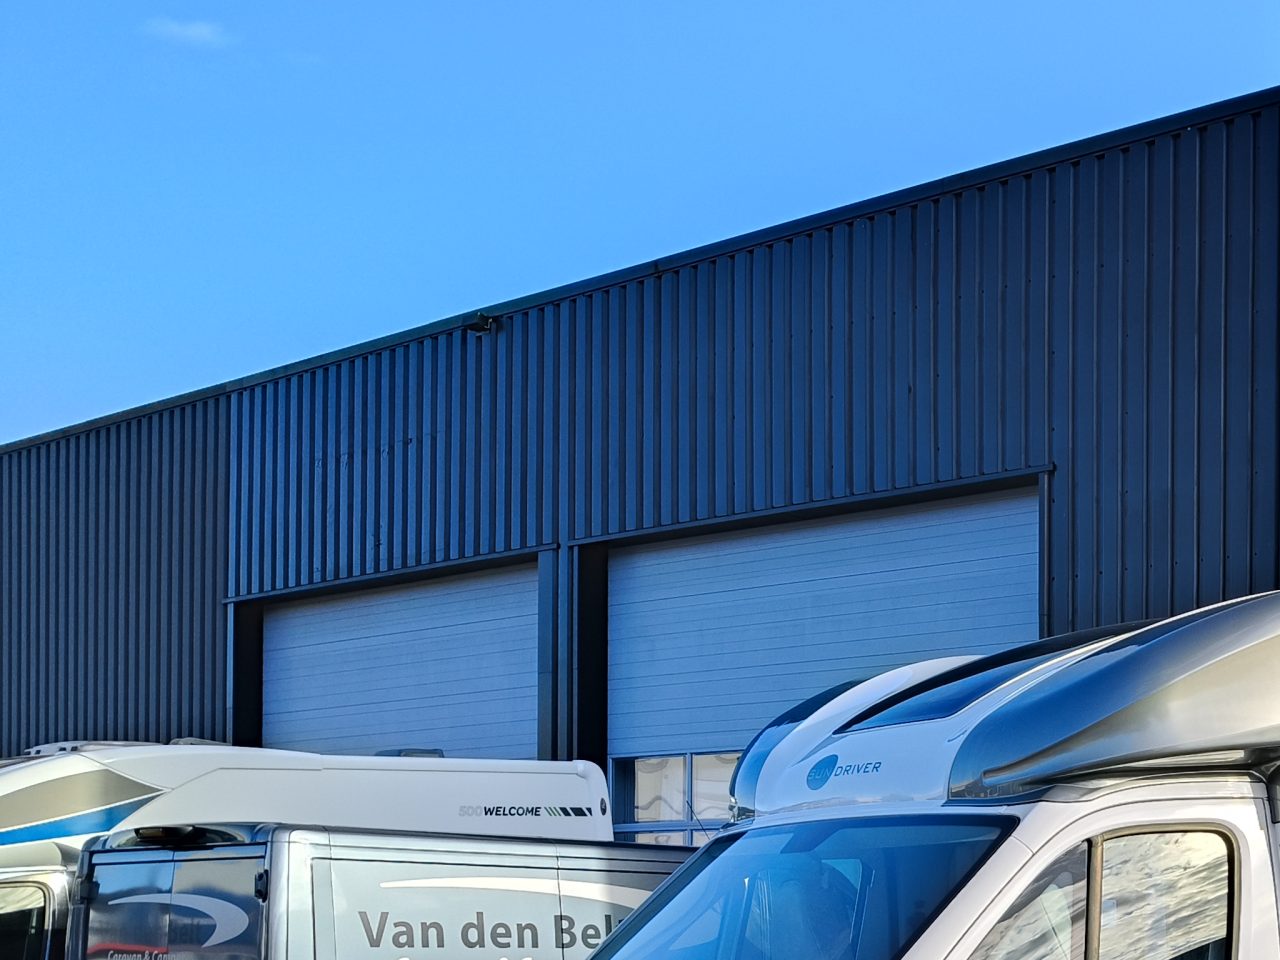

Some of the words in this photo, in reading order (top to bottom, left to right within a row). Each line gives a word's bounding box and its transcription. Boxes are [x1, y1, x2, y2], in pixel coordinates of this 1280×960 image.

[834, 761, 882, 777] DRIVER
[358, 911, 445, 949] Van
[460, 911, 539, 949] den
[553, 914, 628, 950] Bel
